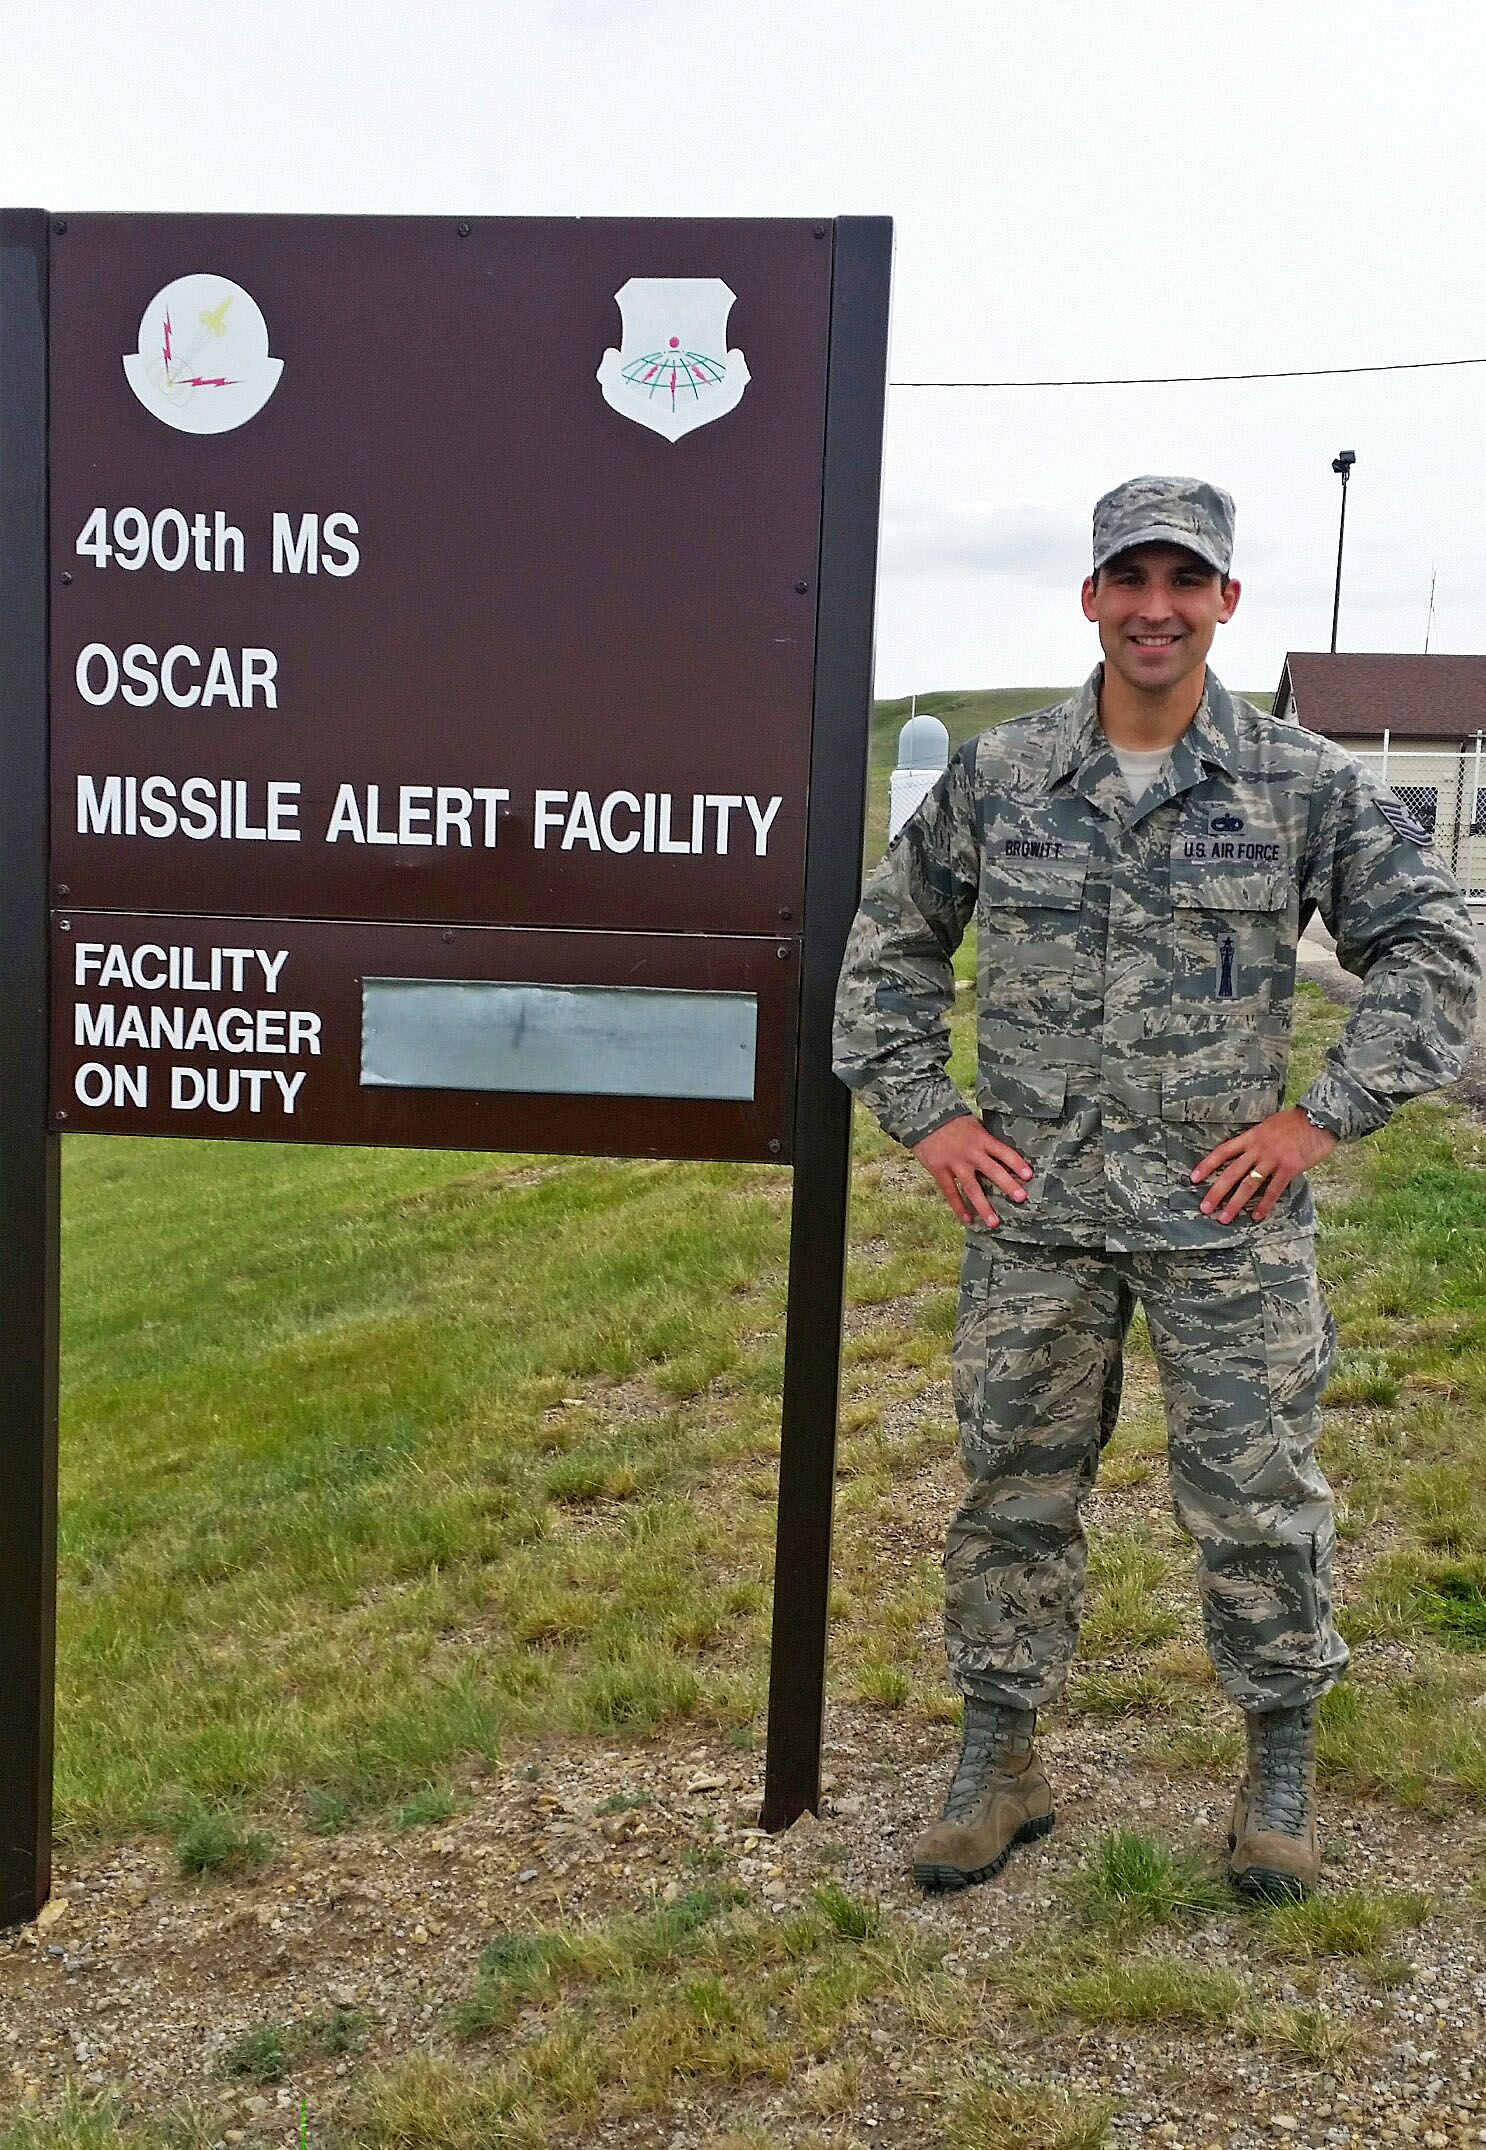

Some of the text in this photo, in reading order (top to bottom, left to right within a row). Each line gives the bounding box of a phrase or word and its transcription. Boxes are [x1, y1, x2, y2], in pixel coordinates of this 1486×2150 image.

[76, 507, 360, 577] 490th MS
[76, 642, 278, 709] OSCAR
[77, 774, 783, 856] MISSILE ALERT FACILITY
[1211, 842, 1234, 858] AIR
[1238, 843, 1280, 861] FORCE
[75, 942, 290, 993] FACILITY
[75, 1003, 322, 1055] MANAGER
[75, 1062, 307, 1114] ON DUTY
